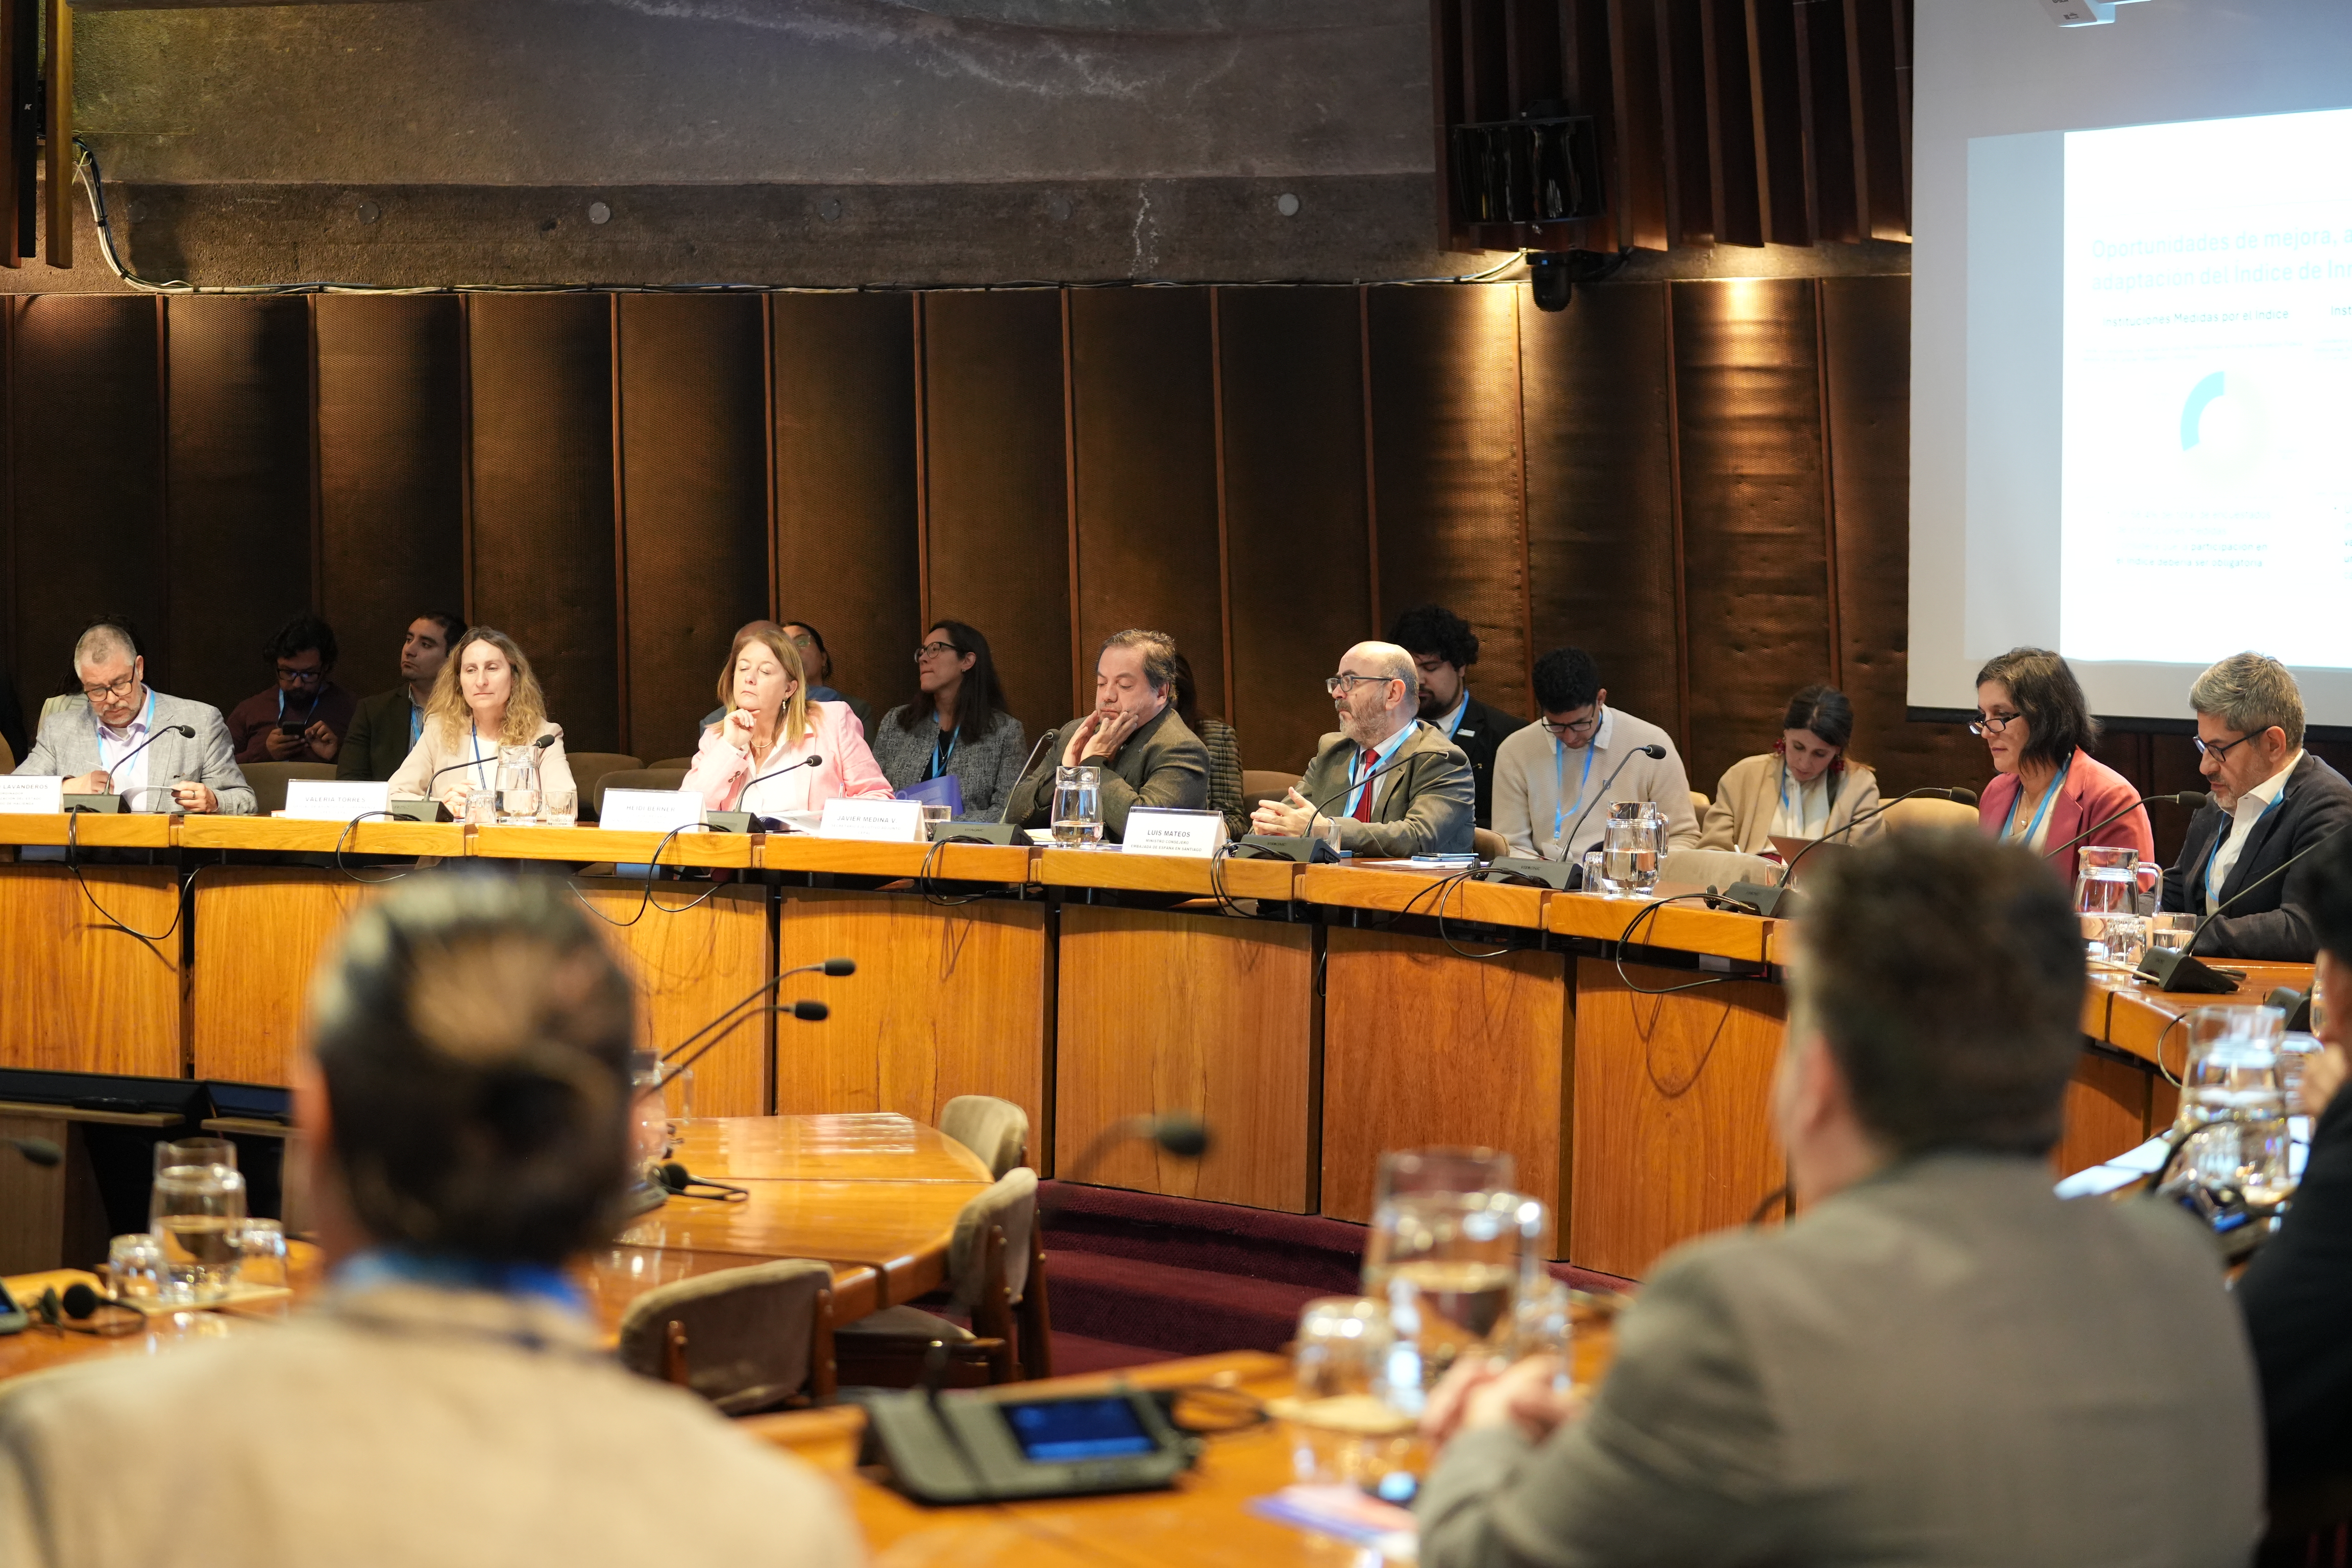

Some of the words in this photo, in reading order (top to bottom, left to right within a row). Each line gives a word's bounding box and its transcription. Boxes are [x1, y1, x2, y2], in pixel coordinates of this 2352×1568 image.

[2092, 233, 2230, 260] Oportunidades
[2236, 231, 2258, 250] de
[2264, 228, 2338, 250] mejora,
[2092, 268, 2194, 292] adaptación
[2200, 266, 2228, 285] del
[2235, 259, 2292, 282] Índice
[2299, 261, 2321, 280] de
[2174, 312, 2219, 323] Medidas
[2222, 313, 2239, 323] por
